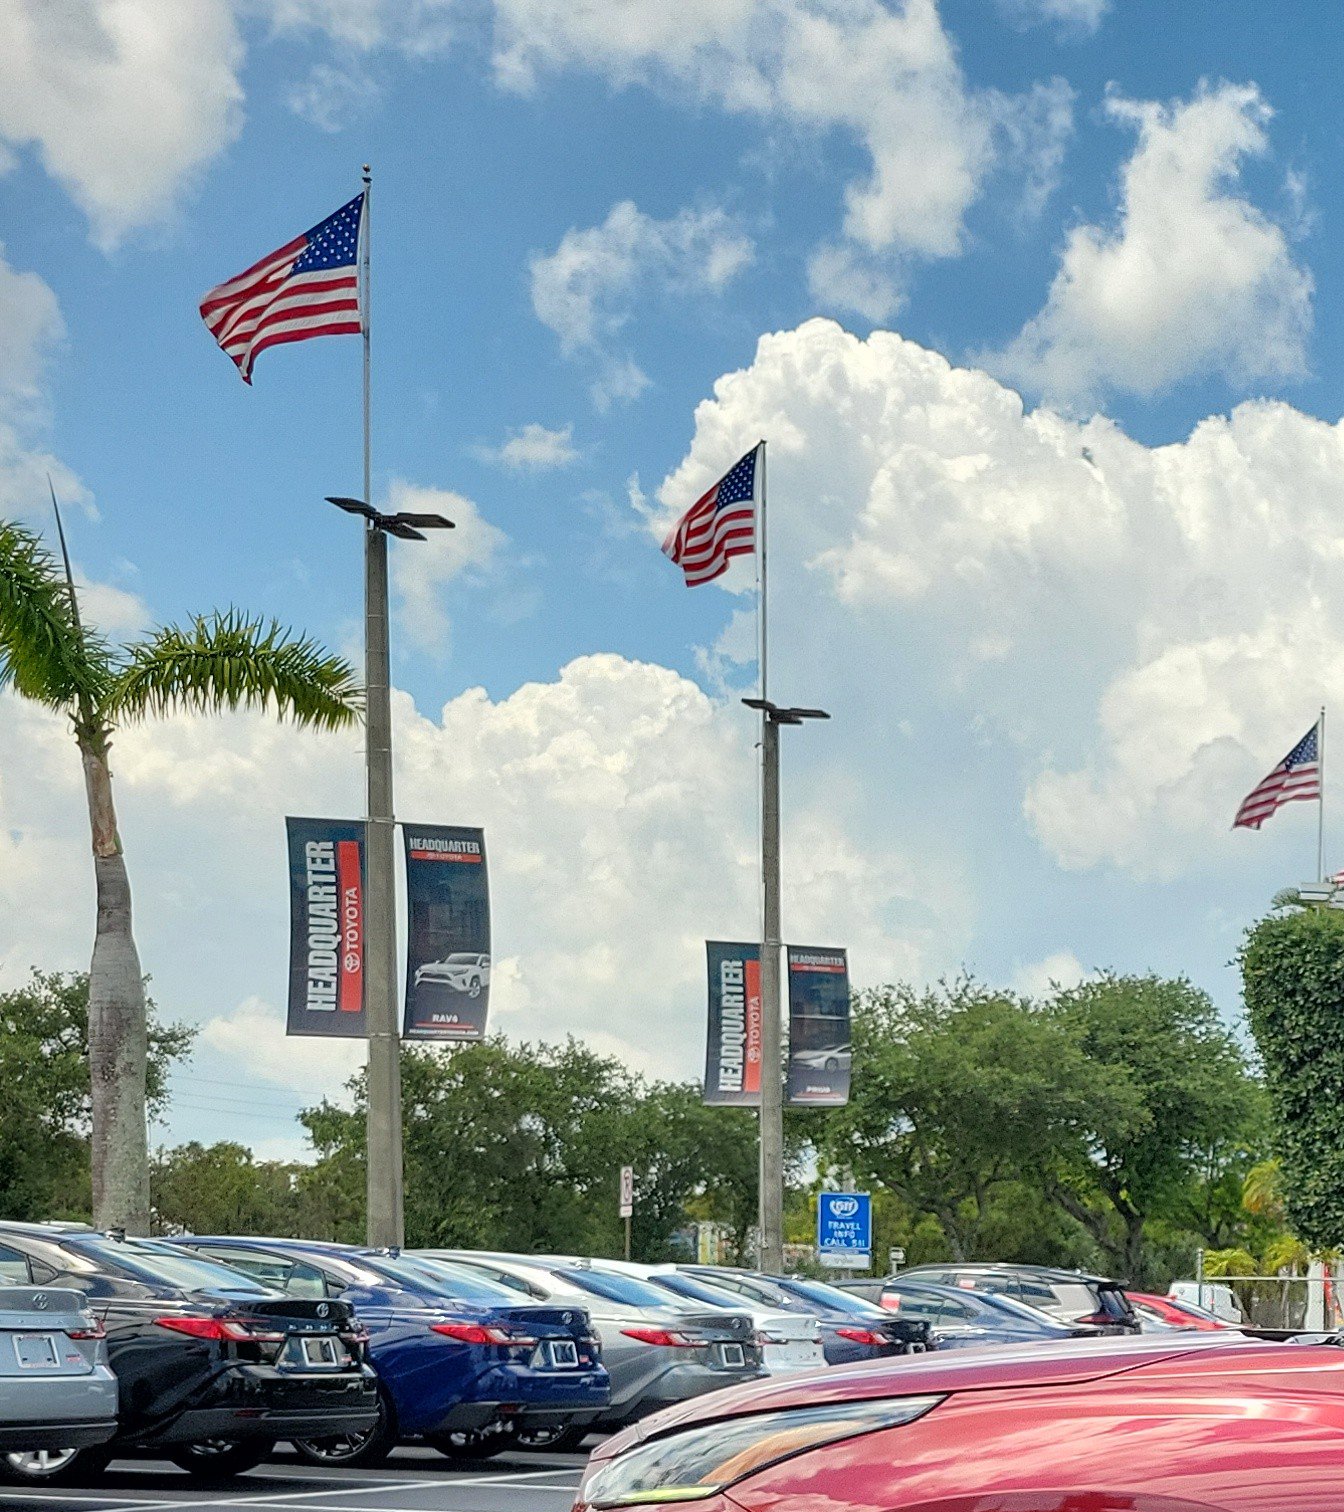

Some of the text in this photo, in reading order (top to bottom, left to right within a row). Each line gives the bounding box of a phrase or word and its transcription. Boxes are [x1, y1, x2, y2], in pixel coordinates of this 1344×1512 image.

[410, 838, 479, 854] HEADQUARTER
[305, 841, 341, 1011] HEADQUARTER
[346, 887, 359, 951] TOYOTA
[718, 959, 747, 1092] HEADQUARTER
[750, 996, 761, 1052] TOYOTA
[824, 1238, 847, 1247] CALL
[828, 1221, 861, 1230] TRAVEL
[834, 1230, 856, 1239] INFO
